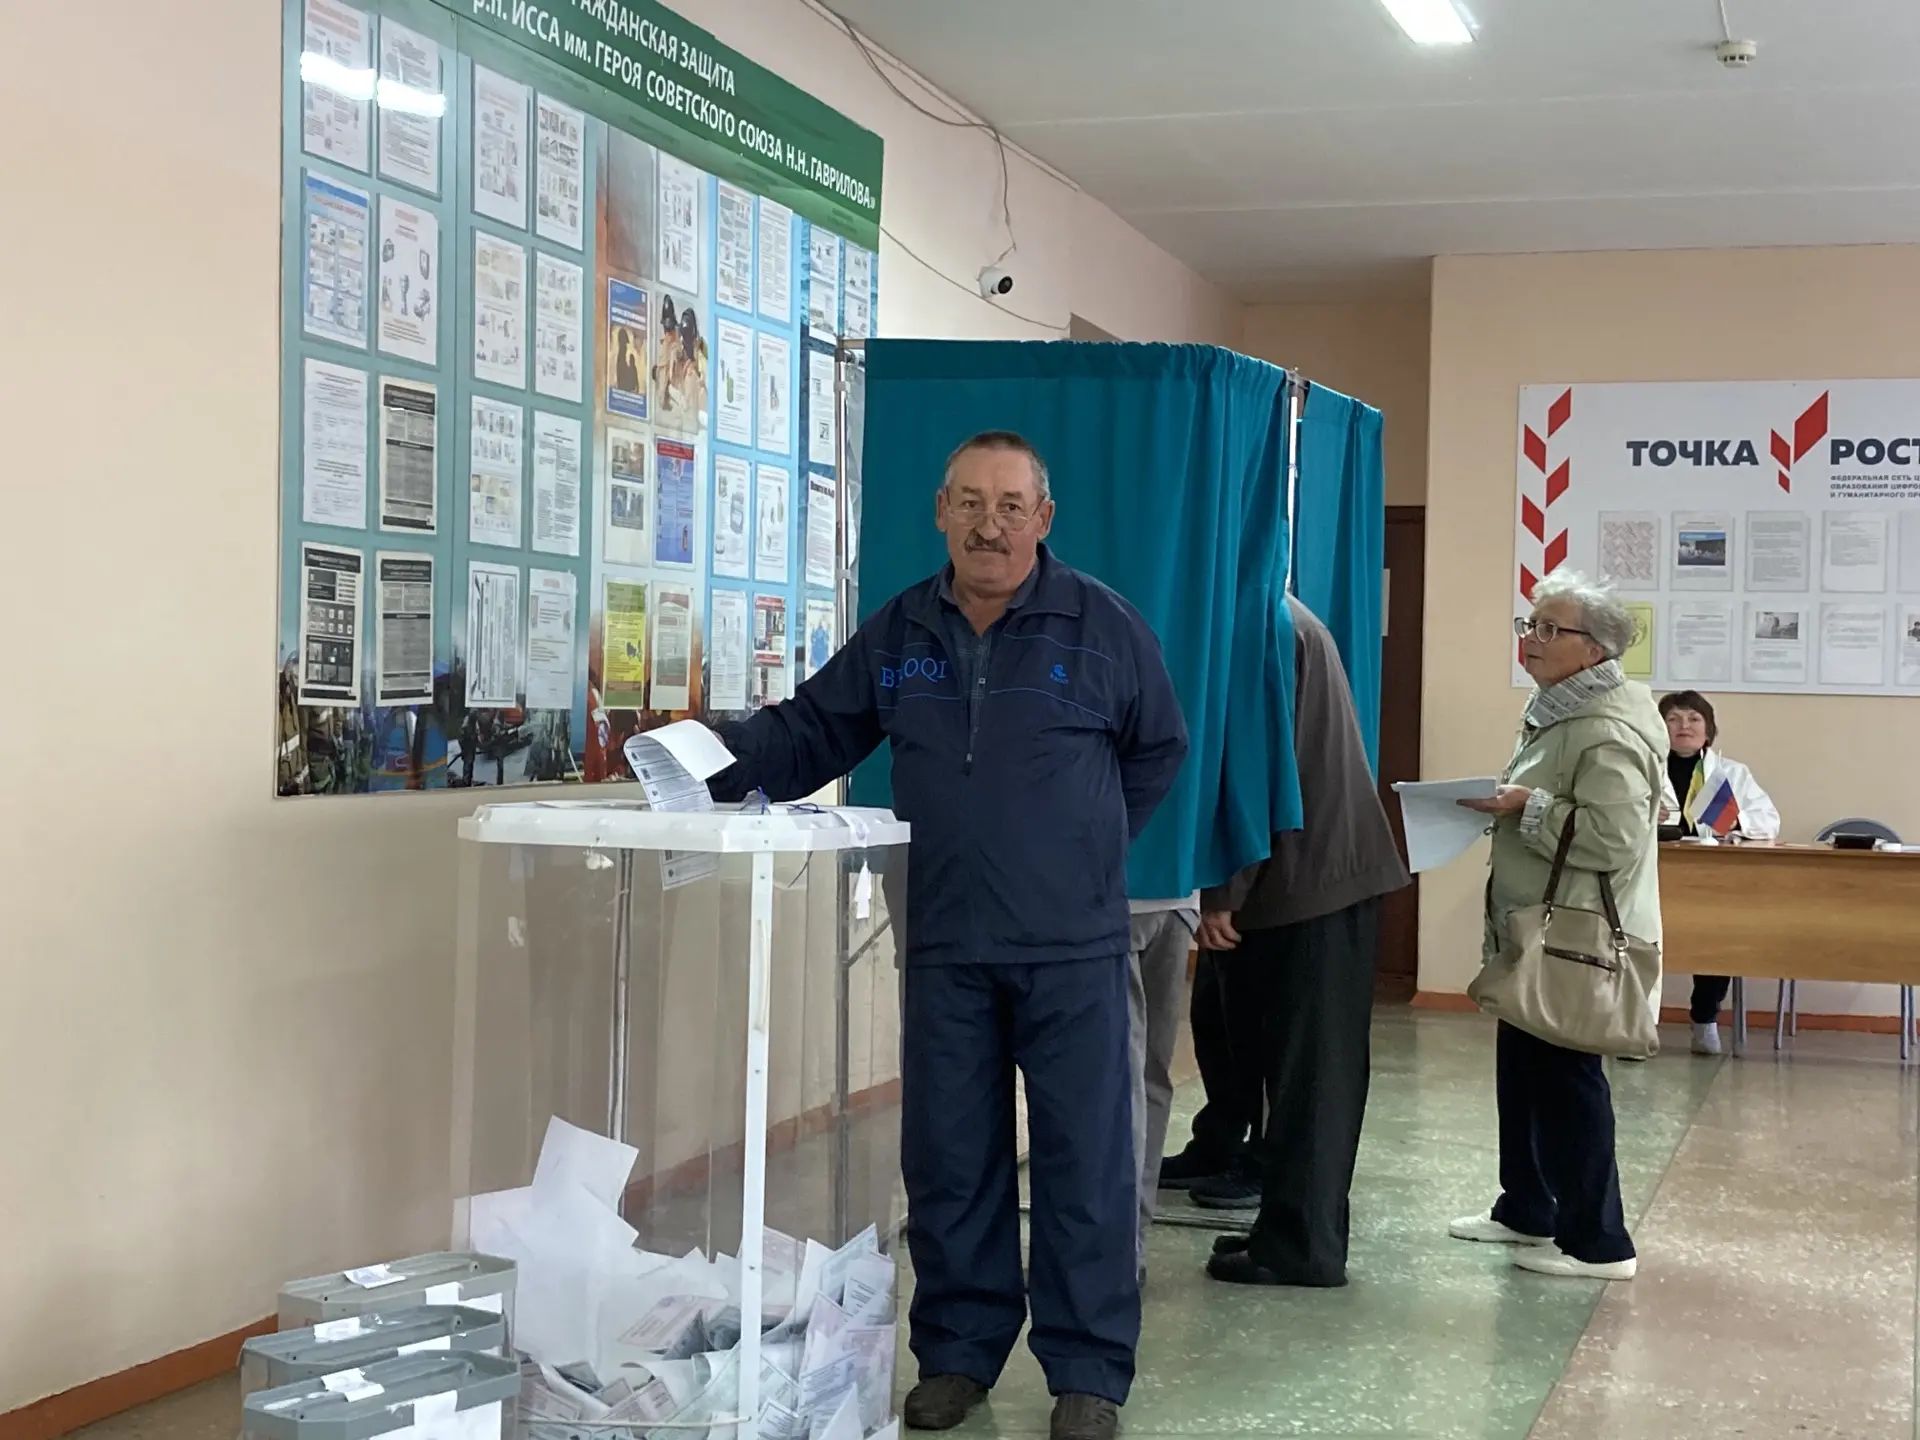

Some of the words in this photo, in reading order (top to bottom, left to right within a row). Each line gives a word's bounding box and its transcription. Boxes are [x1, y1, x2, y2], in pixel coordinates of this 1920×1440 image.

[680, 41, 736, 97] ЗАЩИТА
[511, 0, 560, 47] ИССА
[564, 30, 591, 63] им.
[595, 39, 642, 91] ГЕРОЯ
[646, 70, 735, 138] СОВЕТСКОГО
[738, 119, 783, 164] СОЮЗА
[786, 143, 809, 176] Н.Н.
[810, 156, 876, 210] ГАВРИЛОВА»
[1626, 439, 1760, 467] ТОЧКА
[880, 657, 948, 688] BOQI
